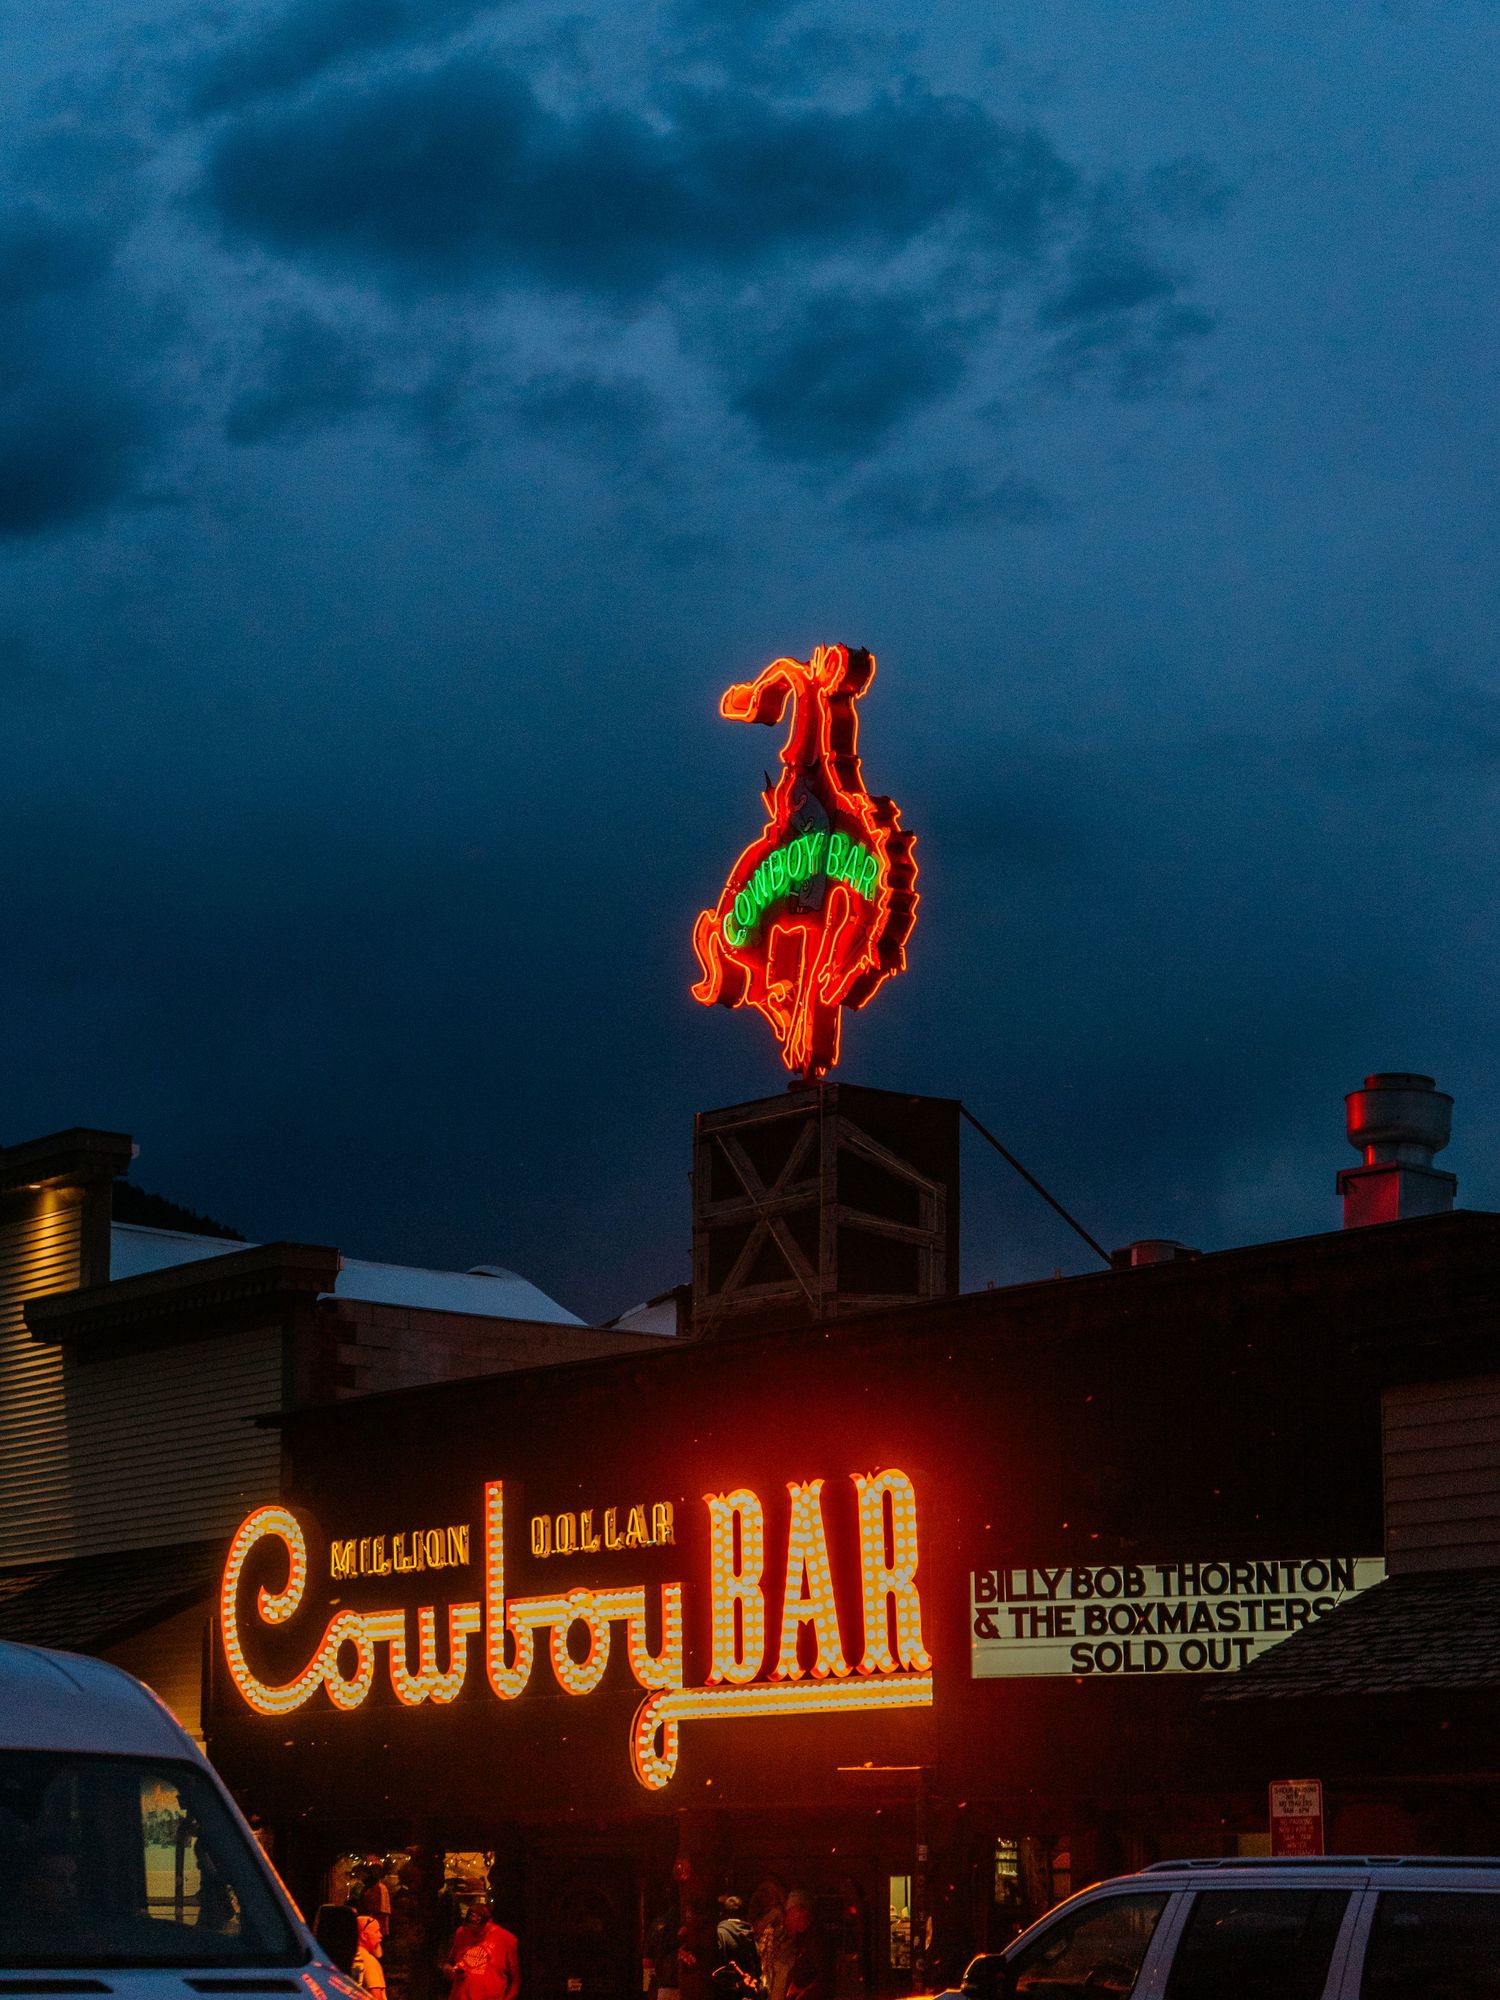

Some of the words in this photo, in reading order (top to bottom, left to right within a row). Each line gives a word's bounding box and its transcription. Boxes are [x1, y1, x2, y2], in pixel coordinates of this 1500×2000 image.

[722, 831, 826, 946] COWBOY
[826, 831, 880, 901] BAR
[330, 1524, 470, 1580] MILLION
[531, 1501, 676, 1558] DOLLAR
[975, 1568, 1067, 1603] BILLY
[1071, 1565, 1146, 1600] BOB
[1156, 1558, 1356, 1597] THORNTON
[221, 1480, 684, 1790] Cowboy
[702, 1469, 933, 1686] BAR
[973, 1607, 1002, 1640] &
[1008, 1605, 1077, 1639] THE
[1084, 1596, 1338, 1636] BOXMASTERS
[1070, 1640, 1169, 1674] SOLD
[1179, 1637, 1255, 1672] OUT
